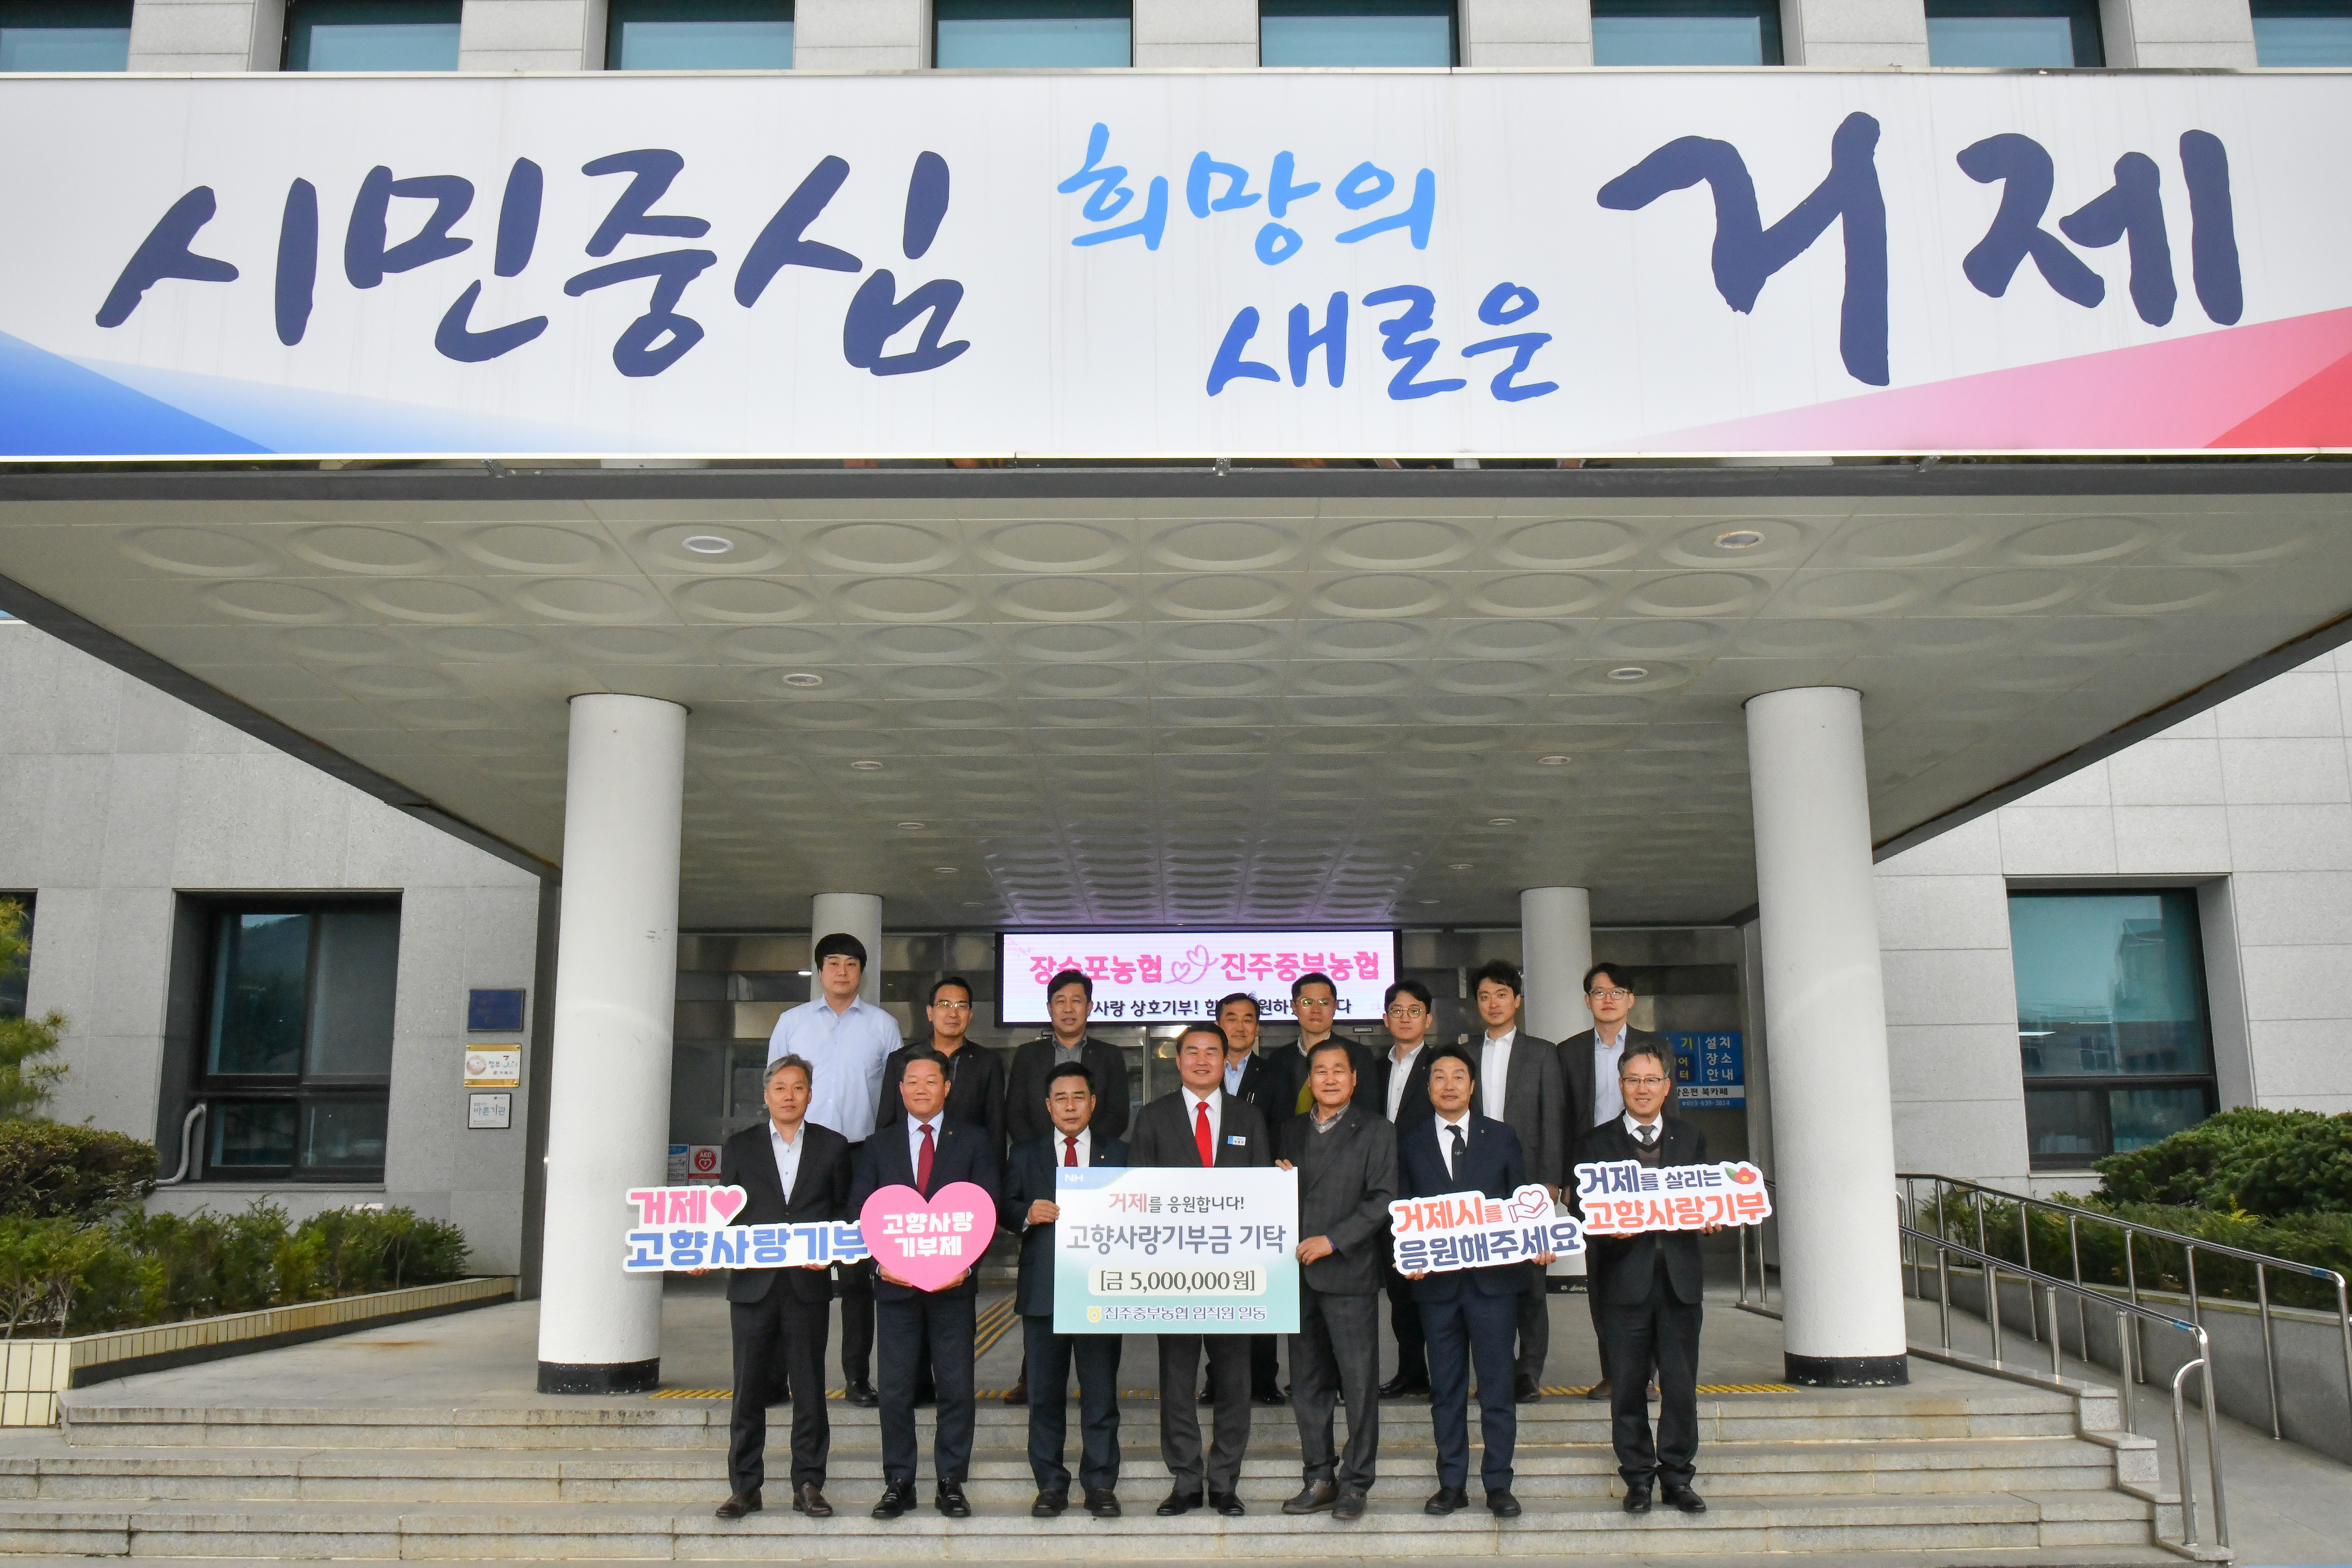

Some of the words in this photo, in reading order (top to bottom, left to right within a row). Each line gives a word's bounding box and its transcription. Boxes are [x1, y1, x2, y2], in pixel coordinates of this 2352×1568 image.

[1058, 123, 1435, 265] 희망의
[96, 149, 971, 377] 시민중심
[1597, 112, 2243, 386] 거제
[1207, 283, 1560, 401] 새로운
[1220, 952, 1378, 981] 진주중부농협
[1130, 1000, 1198, 1017] 상호기부!
[1706, 1053, 1732, 1065] 장소
[1707, 1069, 1733, 1081] 안내
[1702, 1087, 1728, 1096] 북카페
[474, 1103, 506, 1116] 바른기관
[1065, 1174, 1083, 1182] NH
[1580, 1165, 1659, 1194] 거제를
[1665, 1170, 1722, 1189] 살리는
[631, 1190, 707, 1225] 거제
[1109, 1193, 1162, 1213] 거제를
[1167, 1196, 1244, 1213] 응원합니다!
[1394, 1197, 1503, 1233] 거제시를
[1585, 1192, 1766, 1229] 고향사랑기부
[882, 1211, 974, 1234] 고향사랑
[628, 1225, 868, 1267] 고향사랑기부
[895, 1235, 962, 1257] 기부제
[1067, 1224, 1232, 1255] 고향사랑기부금
[1240, 1225, 1286, 1253] 기탁
[1400, 1222, 1581, 1269] 응원해주세요
[1101, 1270, 1123, 1291] [금
[1105, 1307, 1188, 1320] 진주중부농협
[1193, 1307, 1234, 1320] 임직원
[1239, 1307, 1266, 1320] 일동
